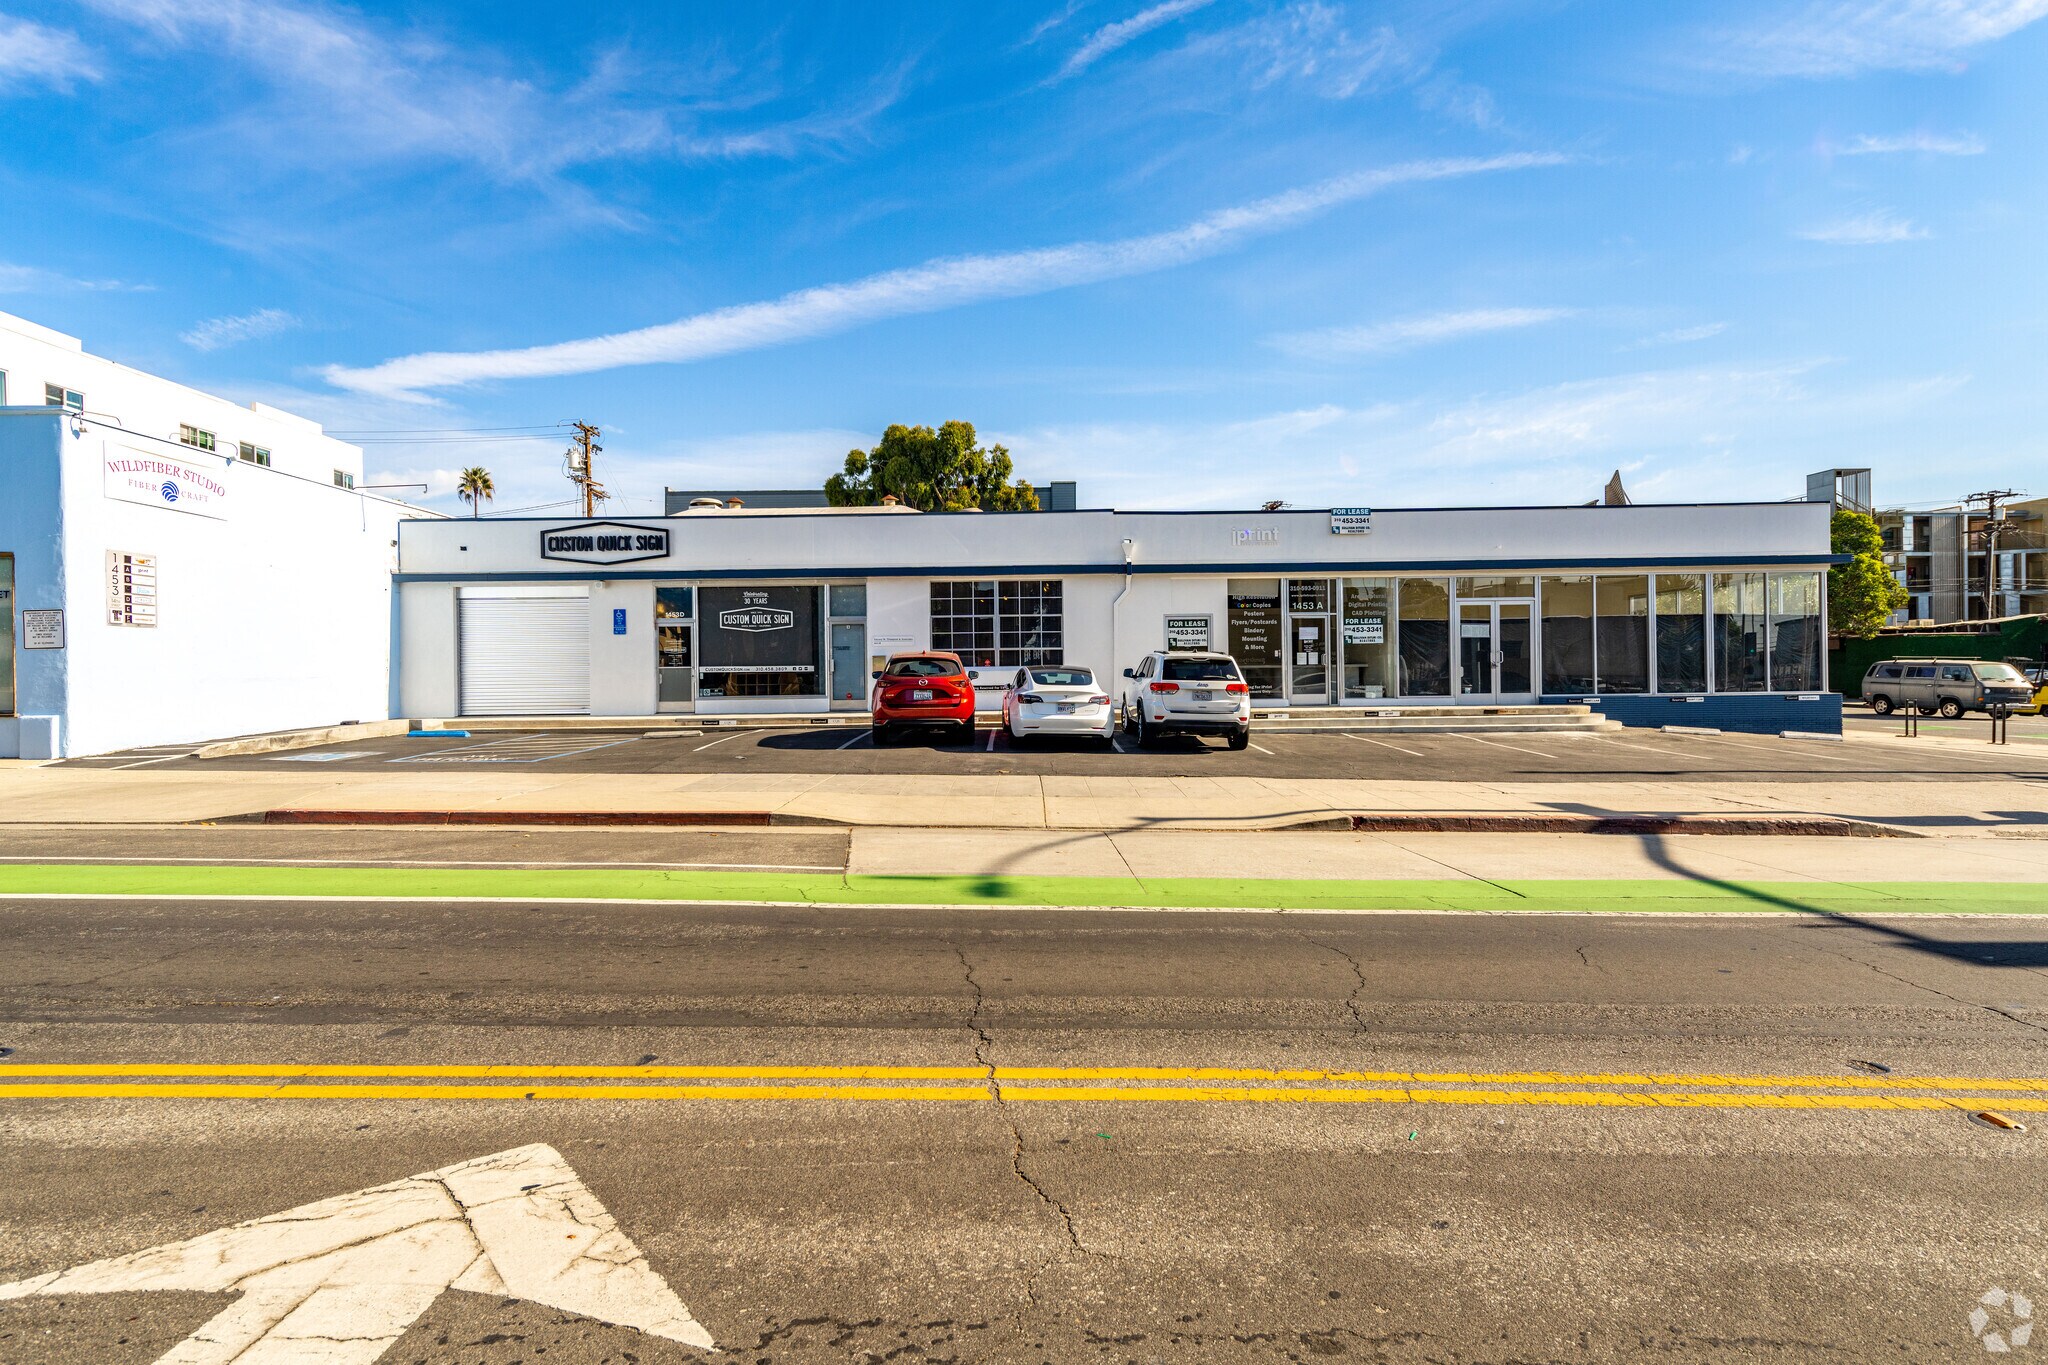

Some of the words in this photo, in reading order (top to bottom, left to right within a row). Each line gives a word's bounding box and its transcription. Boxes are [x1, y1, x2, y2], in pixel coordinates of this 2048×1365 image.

[107, 460, 181, 478] WILDFIBER
[182, 469, 226, 497] STUDIO
[128, 478, 157, 492] FIBER
[181, 490, 209, 503] CRAFT
[547, 536, 594, 552] CUSTOM
[596, 535, 632, 552] QUICK
[636, 535, 664, 551] SIGN
[1292, 602, 1314, 610] 1453
[1316, 602, 1324, 610] A
[723, 614, 750, 625] CUSTOM
[751, 614, 772, 625] QUICK
[773, 614, 790, 624] SIGN
